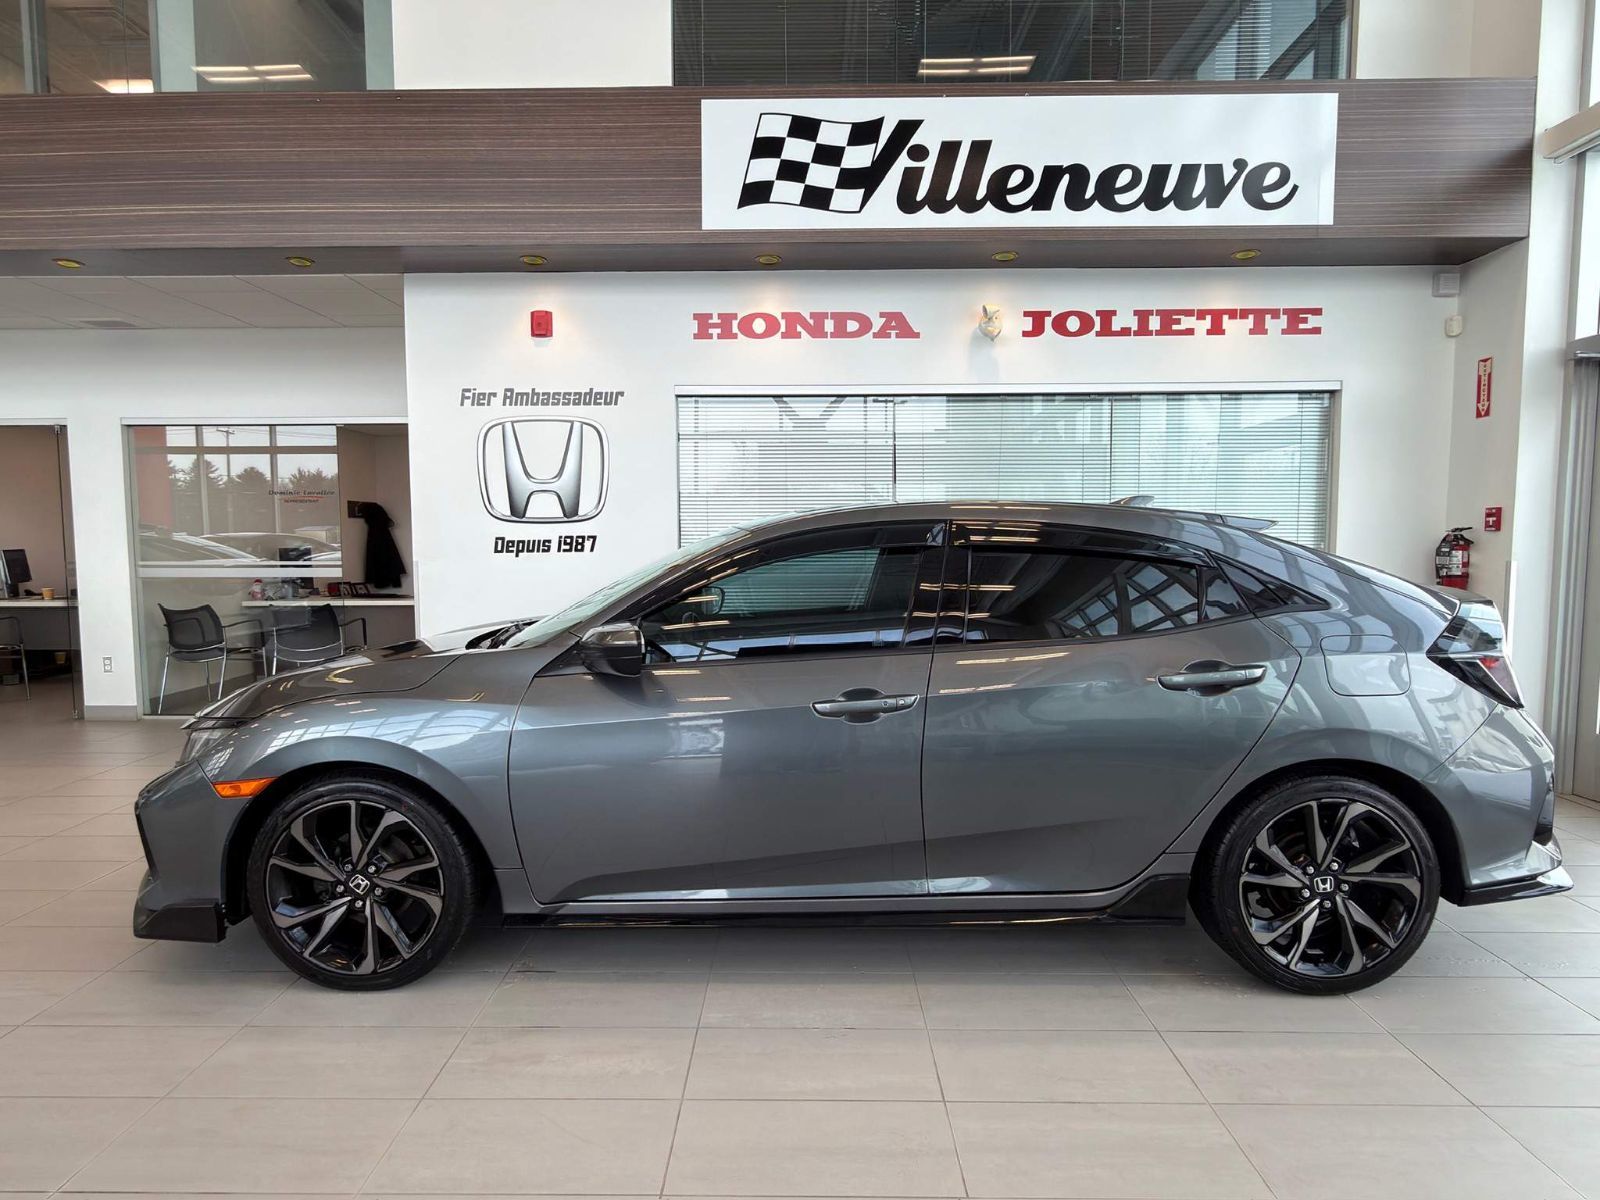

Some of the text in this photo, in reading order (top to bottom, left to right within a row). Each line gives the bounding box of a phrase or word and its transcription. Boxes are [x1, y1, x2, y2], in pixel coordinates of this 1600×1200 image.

[861, 116, 1299, 216] Villeneuve
[693, 307, 1322, 340] HONDA JOLIETTE
[459, 387, 625, 407] Fier Ambassadeur
[493, 534, 598, 558] Depuis 1987
